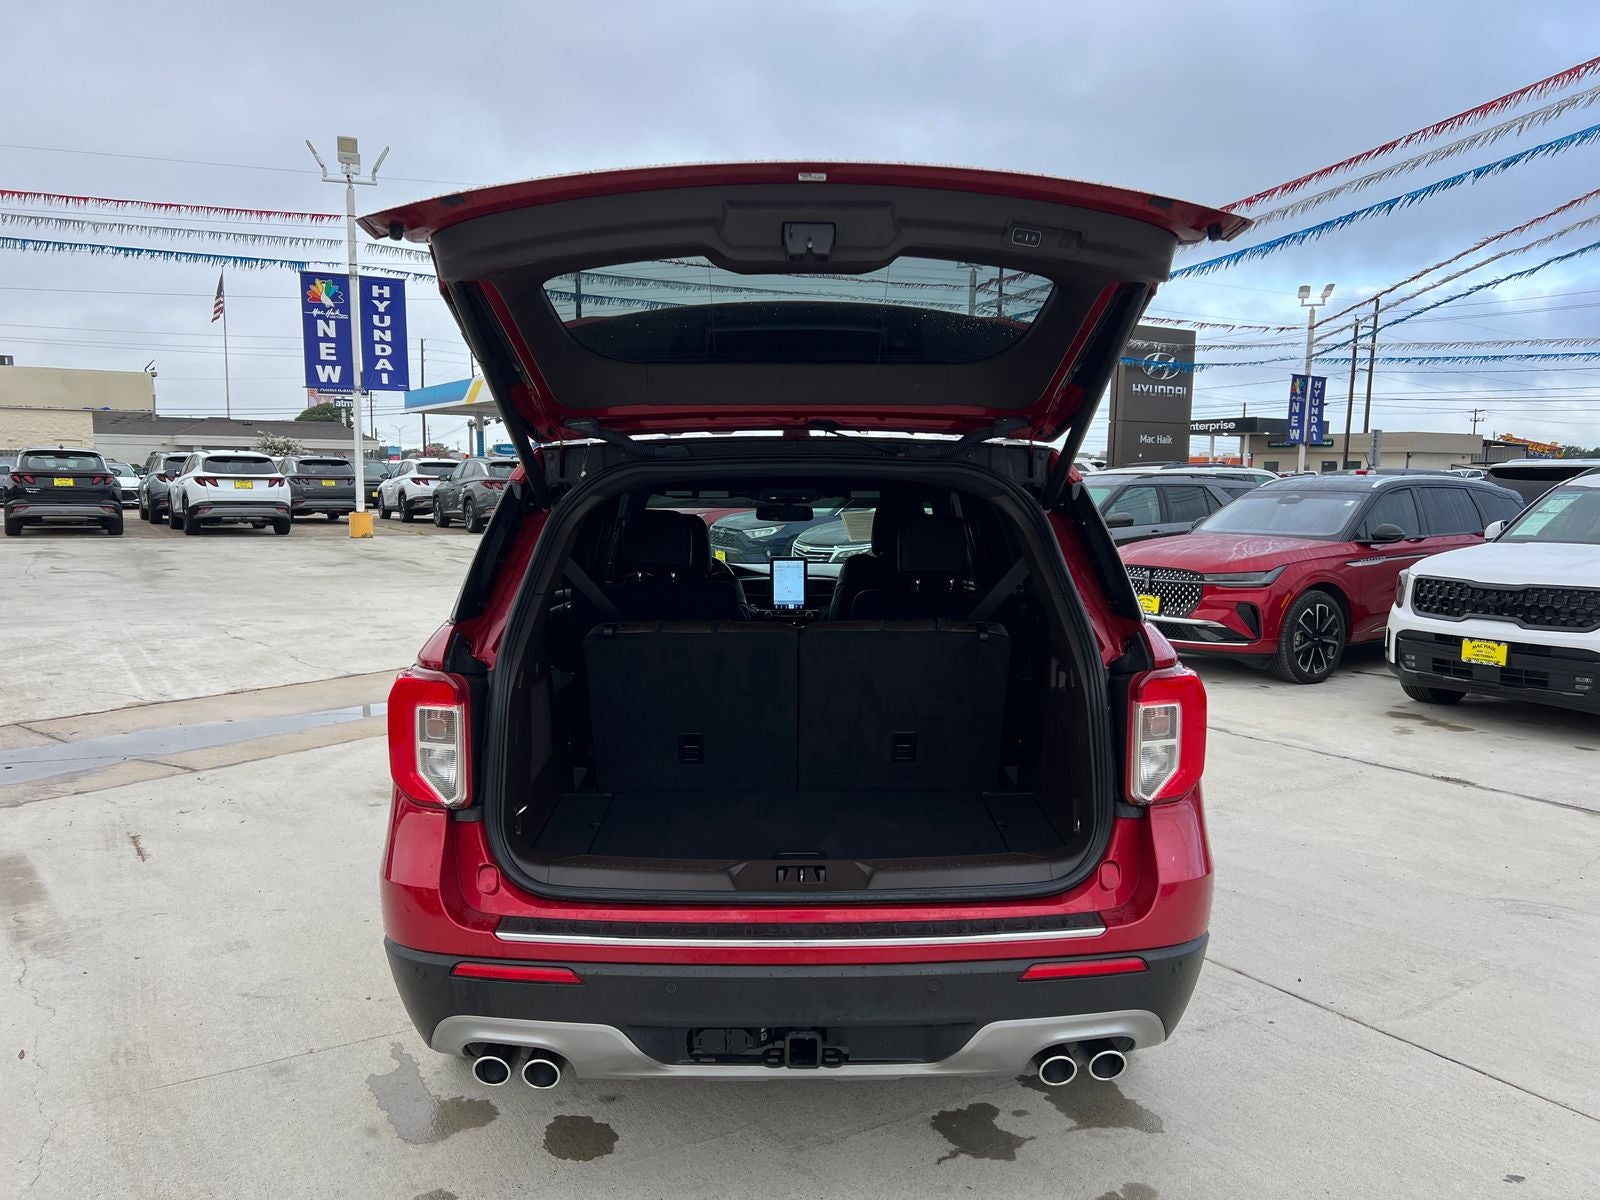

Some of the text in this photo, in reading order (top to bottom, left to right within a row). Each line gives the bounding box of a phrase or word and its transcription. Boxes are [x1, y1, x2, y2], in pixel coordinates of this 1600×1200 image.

[315, 319, 342, 384] NEW
[371, 285, 394, 385] HYUNDAI
[1132, 383, 1187, 395] HYUNDAI
[1190, 420, 1236, 432] nterprise
[1289, 402, 1301, 441] NEW
[1310, 380, 1322, 441] HYUNDAI
[1139, 433, 1173, 445] Mac Haik
